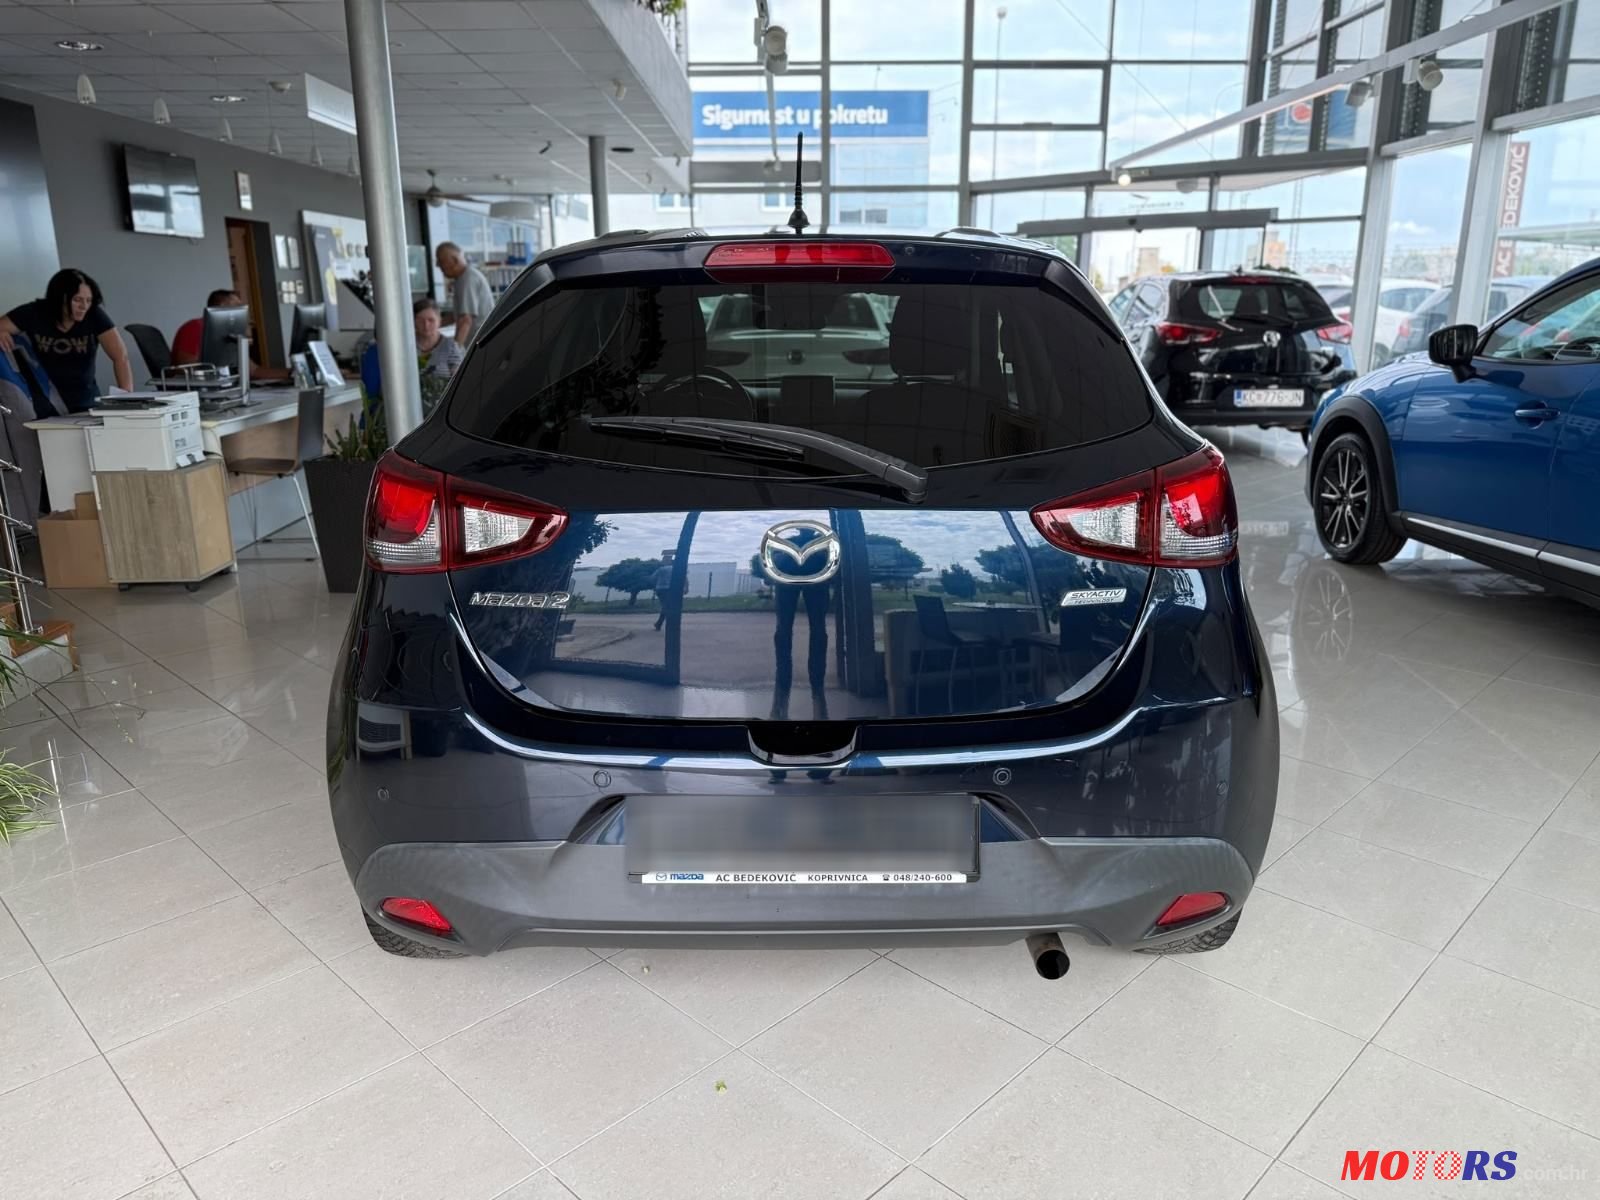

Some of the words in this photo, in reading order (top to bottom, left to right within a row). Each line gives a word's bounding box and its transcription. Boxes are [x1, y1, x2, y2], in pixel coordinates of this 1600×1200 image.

[796, 109, 810, 125] u
[1500, 145, 1526, 247] BDEKOVIĆ
[35, 334, 89, 354] WOW
[1071, 590, 1121, 599] SKYACTIV
[715, 874, 730, 882] AC
[733, 872, 797, 882] BEDEKOVIĆ
[807, 874, 869, 882] KOPRIVNICA
[893, 873, 953, 882] 048/240-600
